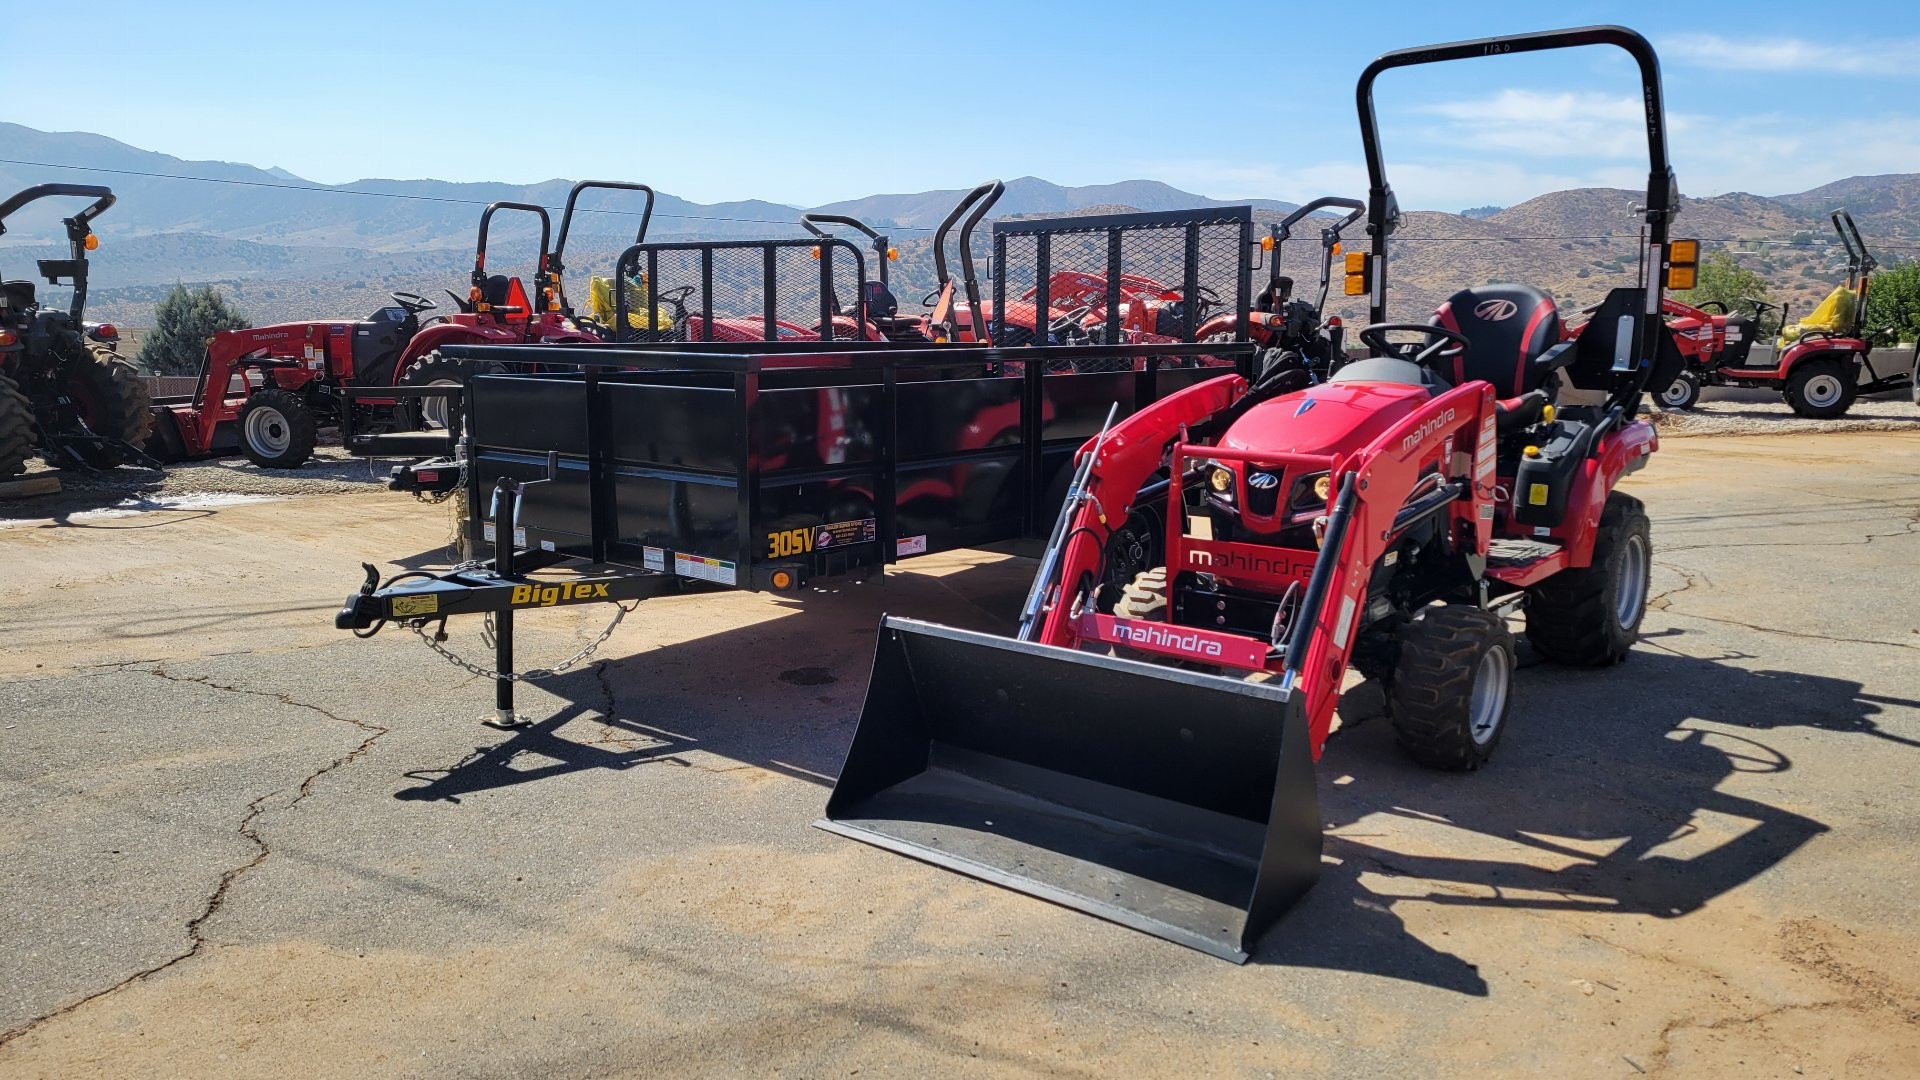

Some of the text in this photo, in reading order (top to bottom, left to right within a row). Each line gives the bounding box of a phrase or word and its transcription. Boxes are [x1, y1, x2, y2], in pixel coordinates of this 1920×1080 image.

[1402, 407, 1455, 451] mahindra
[1189, 549, 1314, 579] mahindra
[510, 581, 611, 607] BigTex
[1112, 623, 1222, 656] mahindra
